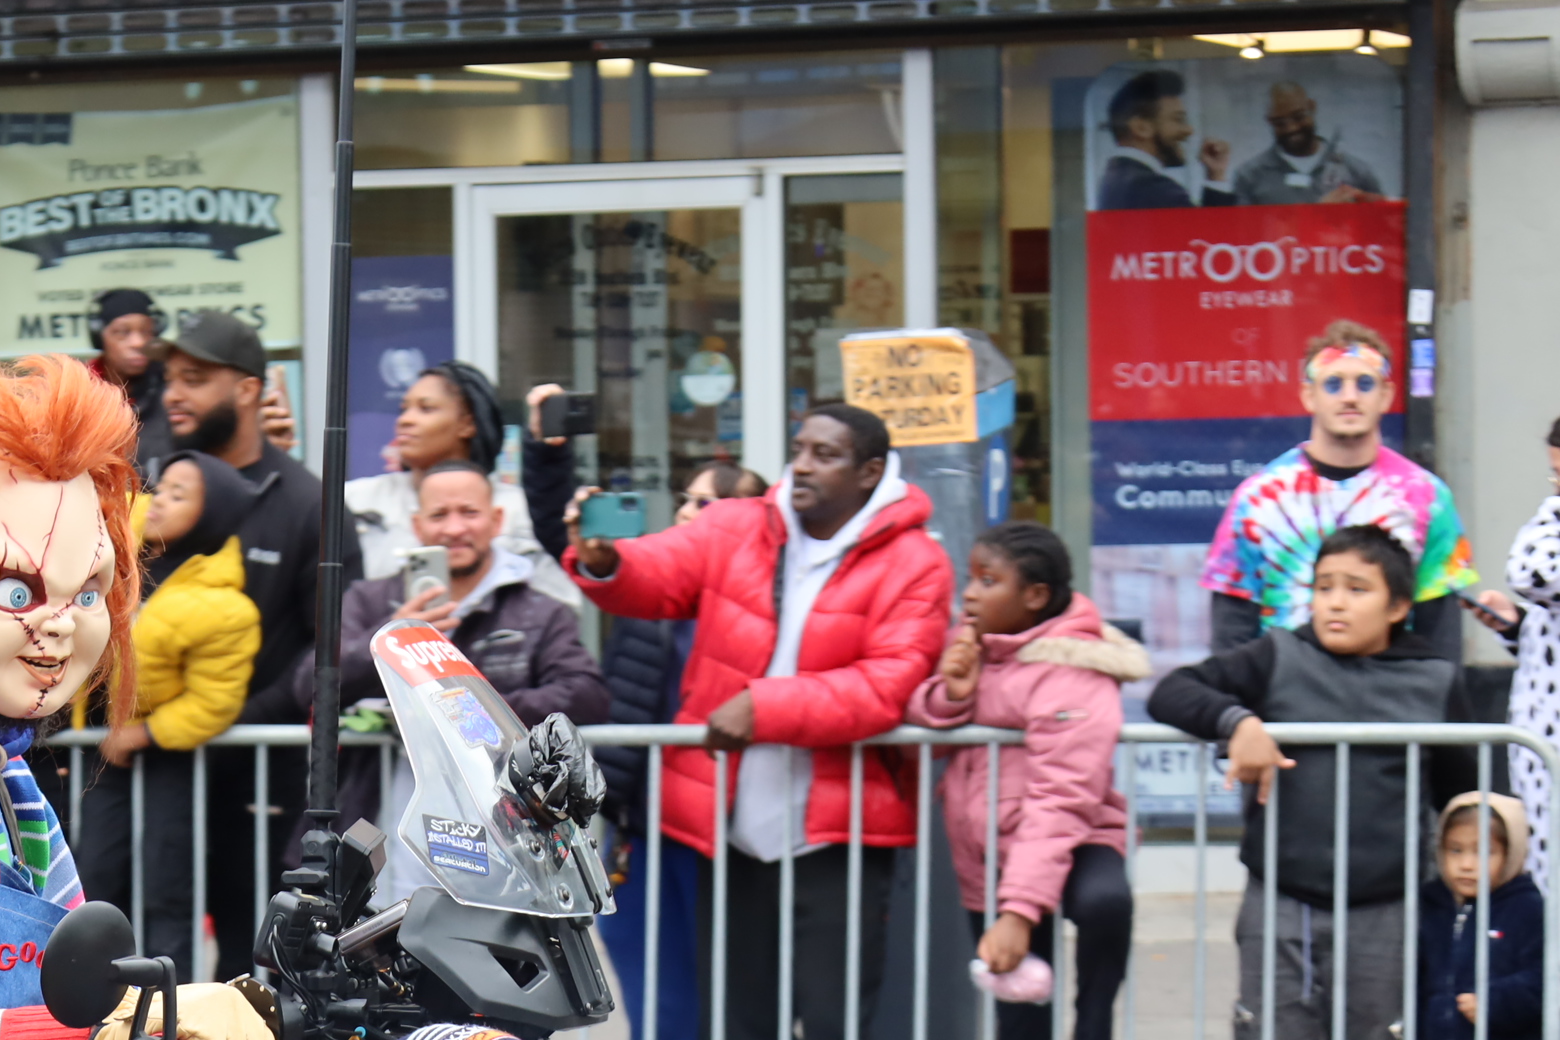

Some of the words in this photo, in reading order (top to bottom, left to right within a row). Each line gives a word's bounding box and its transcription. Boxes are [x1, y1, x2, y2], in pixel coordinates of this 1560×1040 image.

[67, 159, 137, 182] Ponce
[145, 152, 203, 178] Bank
[130, 187, 279, 229] BRONX
[1198, 289, 1294, 309] EYEWEAR
[887, 344, 919, 368] NO
[853, 371, 961, 398] PARKING
[1112, 360, 1288, 388] SOUTHERN
